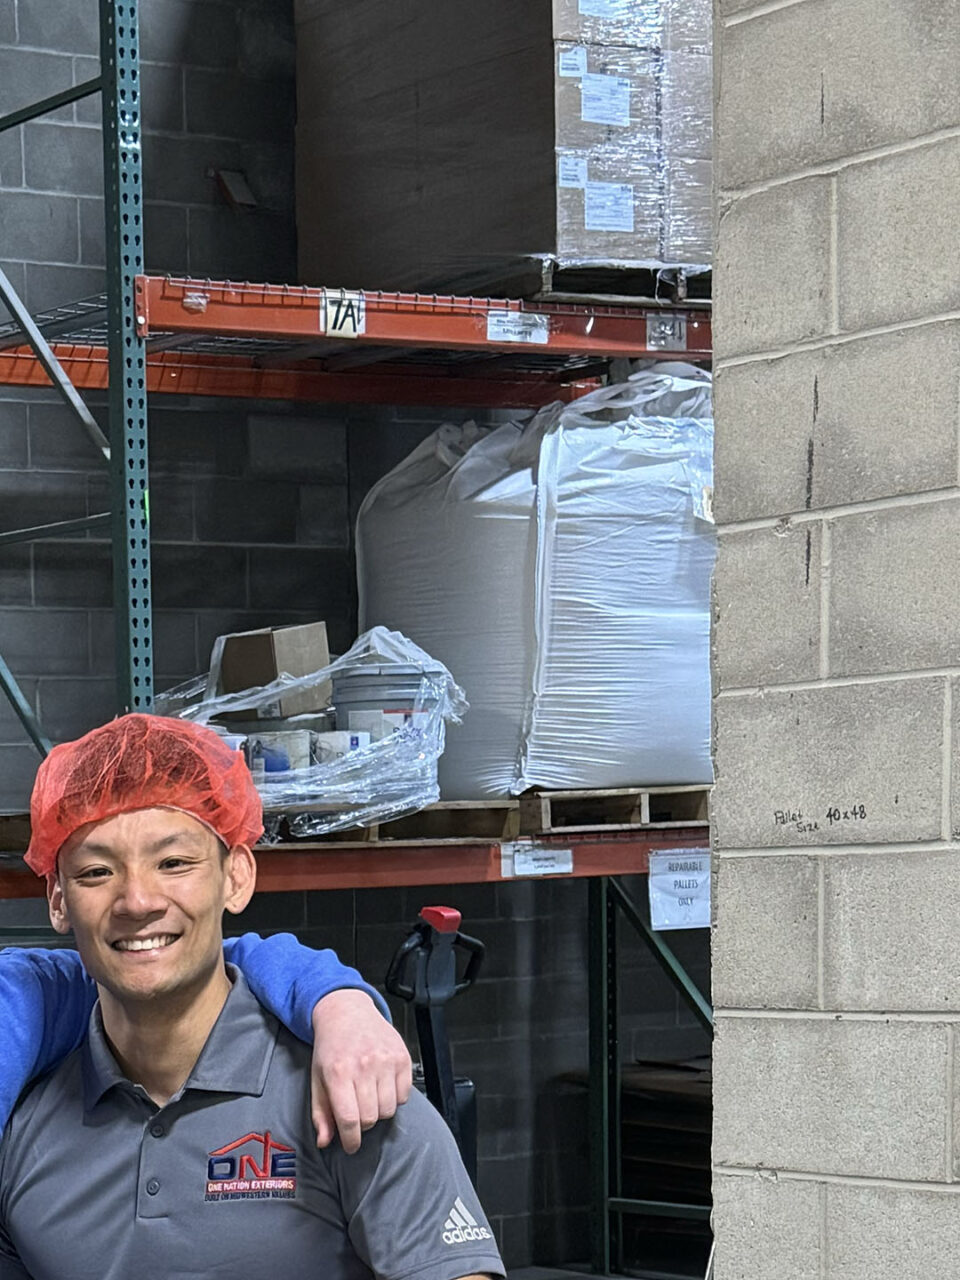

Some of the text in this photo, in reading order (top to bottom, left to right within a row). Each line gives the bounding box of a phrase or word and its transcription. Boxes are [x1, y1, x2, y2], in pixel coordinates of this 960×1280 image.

[329, 300, 357, 333] 7A
[668, 861, 702, 873] REPAIRABLE
[673, 879, 699, 890] PALLETS
[207, 1138, 297, 1180] ONE
[223, 1181, 250, 1191] NATION
[251, 1180, 294, 1190] EXTERIORS
[442, 1226, 492, 1244] adidas
